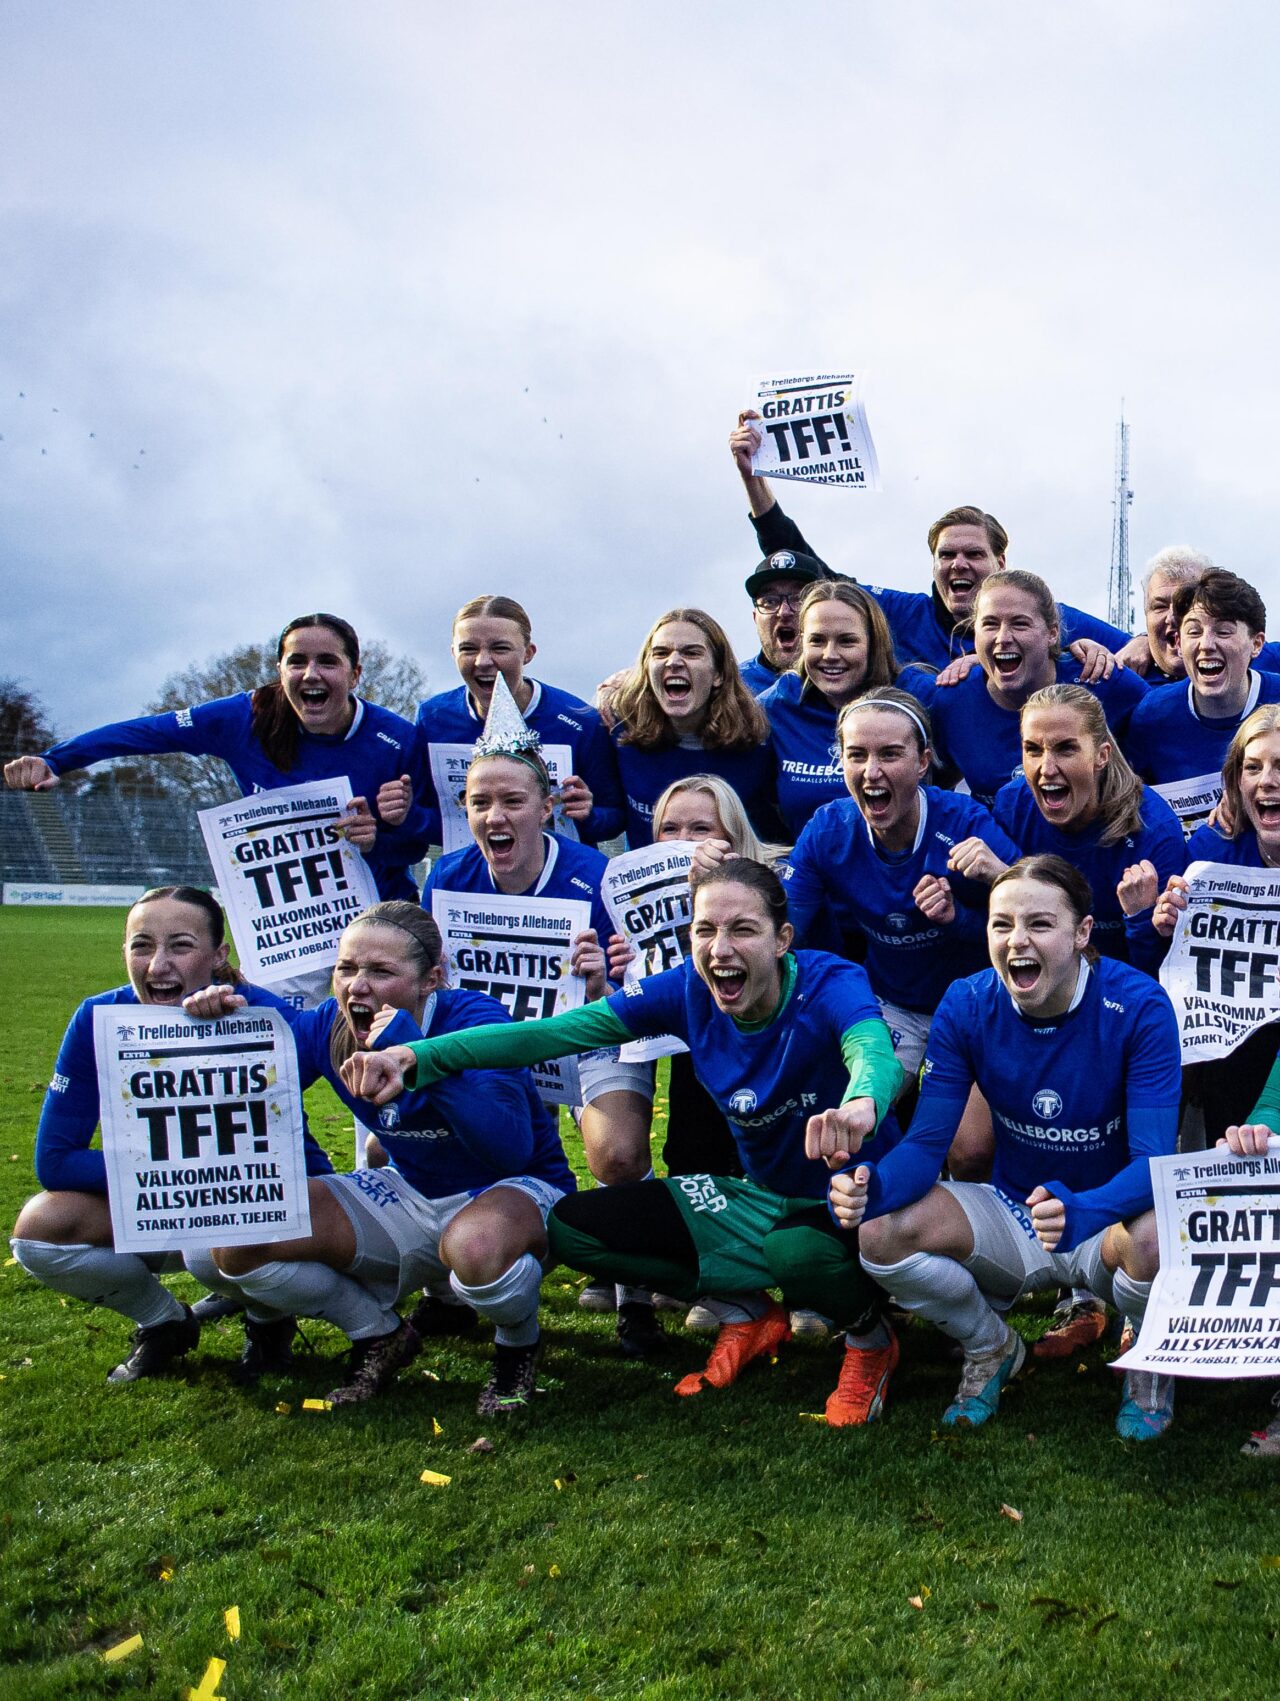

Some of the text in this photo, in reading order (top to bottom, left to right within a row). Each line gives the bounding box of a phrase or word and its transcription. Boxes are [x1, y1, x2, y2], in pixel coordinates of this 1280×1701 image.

[771, 376, 814, 387] Trelleborgs
[762, 391, 845, 419] GRATTIS
[765, 412, 852, 462] TFF!
[837, 457, 862, 471] TILL
[803, 471, 865, 483] ENSKAN
[557, 713, 579, 730] CRAFT
[782, 760, 844, 776] TRELLEBO
[791, 775, 844, 784] DAMALLSVENS
[233, 796, 338, 823] Trelleborgs Allehanda
[1167, 792, 1213, 809] Trelleborgs
[234, 825, 340, 863] GRATTIS
[243, 850, 348, 909] TFF!
[618, 855, 693, 885] Trelleborgs Alleh
[1208, 880, 1266, 898] Trelleborgs
[252, 895, 361, 932] VÄLKOMNA TILL
[463, 911, 571, 931] Trelleborgs Allehanda
[625, 893, 692, 934] GRATT
[259, 949, 297, 967] STARKT
[457, 949, 562, 981] GRATTIS
[1183, 996, 1266, 1022] VÄLKOMNA
[138, 1018, 273, 1041] Trelleborgs Allehanda
[1182, 1034, 1223, 1048] STARKT
[123, 1051, 150, 1059] EXTRA
[130, 1064, 268, 1099] GRATTIS
[800, 1092, 818, 1107] FF
[136, 1101, 269, 1161] TFF!
[1000, 1114, 1121, 1142] ELLEBORGS FF
[136, 1163, 280, 1188] VÄLKOMNA TILL
[1193, 1161, 1261, 1178] Trelleborgs
[136, 1183, 284, 1211] ALLSVENSKAN
[672, 1176, 707, 1212] PORT
[693, 1174, 727, 1212] NTER
[1180, 1189, 1207, 1197] EXTRA
[137, 1210, 287, 1231] STARKT JOBBAT, TJEJER!
[1168, 1317, 1262, 1334] VÄLKOMNA
[1142, 1355, 1190, 1363] STARKT
